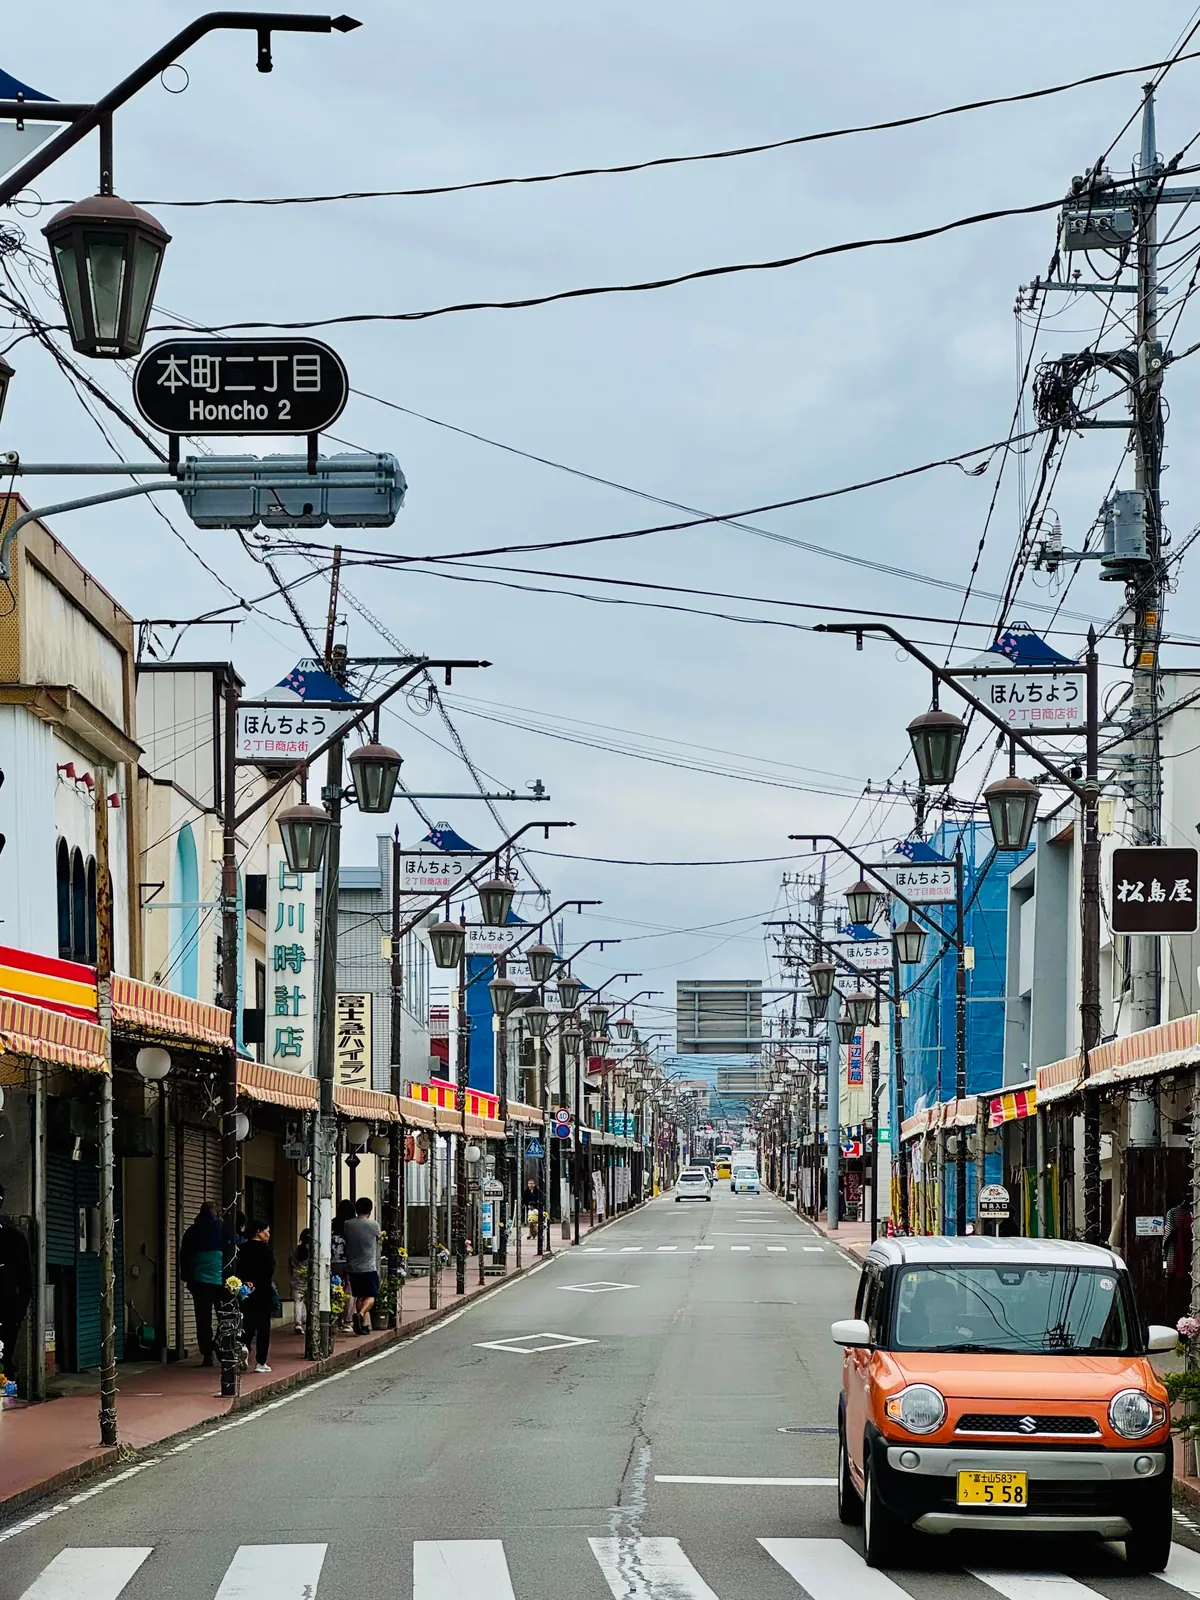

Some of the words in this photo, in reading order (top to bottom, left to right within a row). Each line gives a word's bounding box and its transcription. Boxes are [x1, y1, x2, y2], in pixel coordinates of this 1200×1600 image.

[156, 353, 322, 394] 本町二丁目
[188, 399, 269, 421] Honcho
[277, 399, 292, 421] 2
[990, 681, 1079, 704] ほんちょう
[1008, 707, 1078, 721] 2丁目商店街
[243, 715, 327, 735] ほんちょう
[243, 739, 309, 753] 2丁目商店街
[405, 860, 463, 875] ほんちょう
[895, 870, 952, 885] ほんちょう
[1116, 877, 1194, 904] 松島屋
[469, 930, 514, 941] ほんちょう
[846, 946, 889, 958] ほんちょう
[337, 995, 367, 1089] 富士急ハイラン
[558, 1112, 568, 1120] 40
[973, 1473, 1013, 1484] 富士山583
